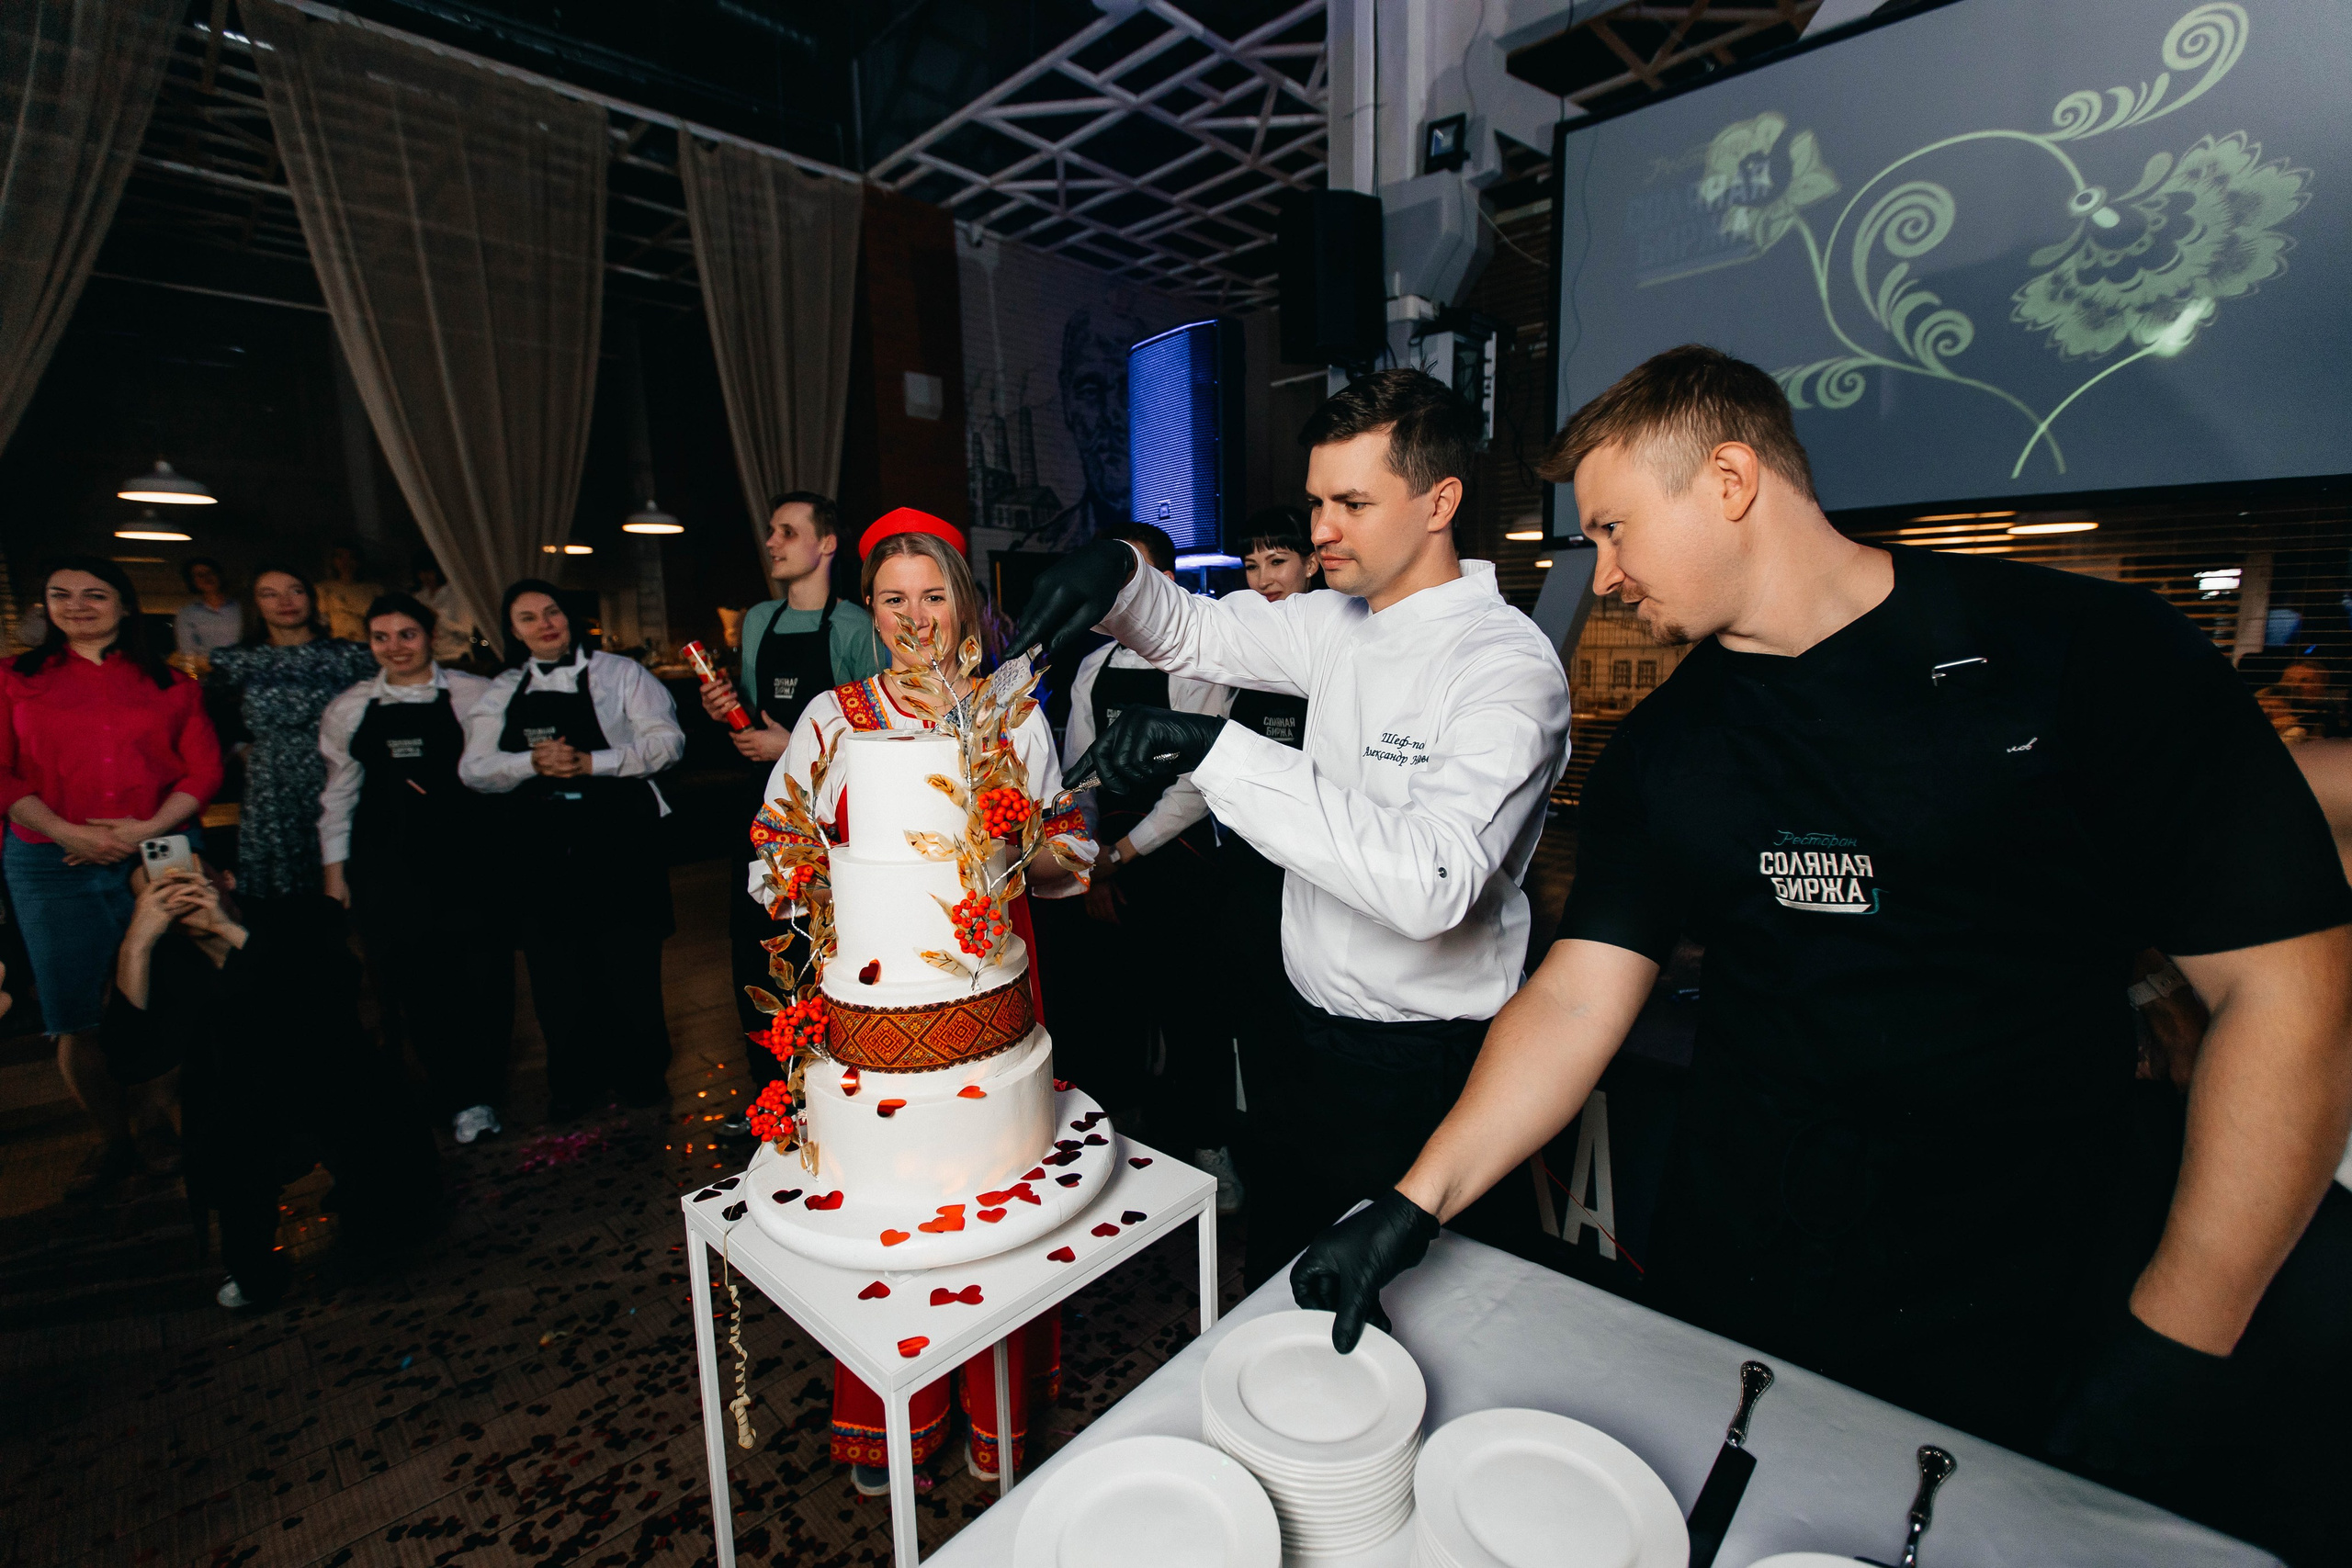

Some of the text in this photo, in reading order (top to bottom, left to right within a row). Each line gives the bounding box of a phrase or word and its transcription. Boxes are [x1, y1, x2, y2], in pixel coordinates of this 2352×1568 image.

[1773, 829, 1858, 849] Ресторан
[1759, 852, 1873, 877] СОЛЯНАЯ
[1770, 877, 1867, 902] БИРЖА
